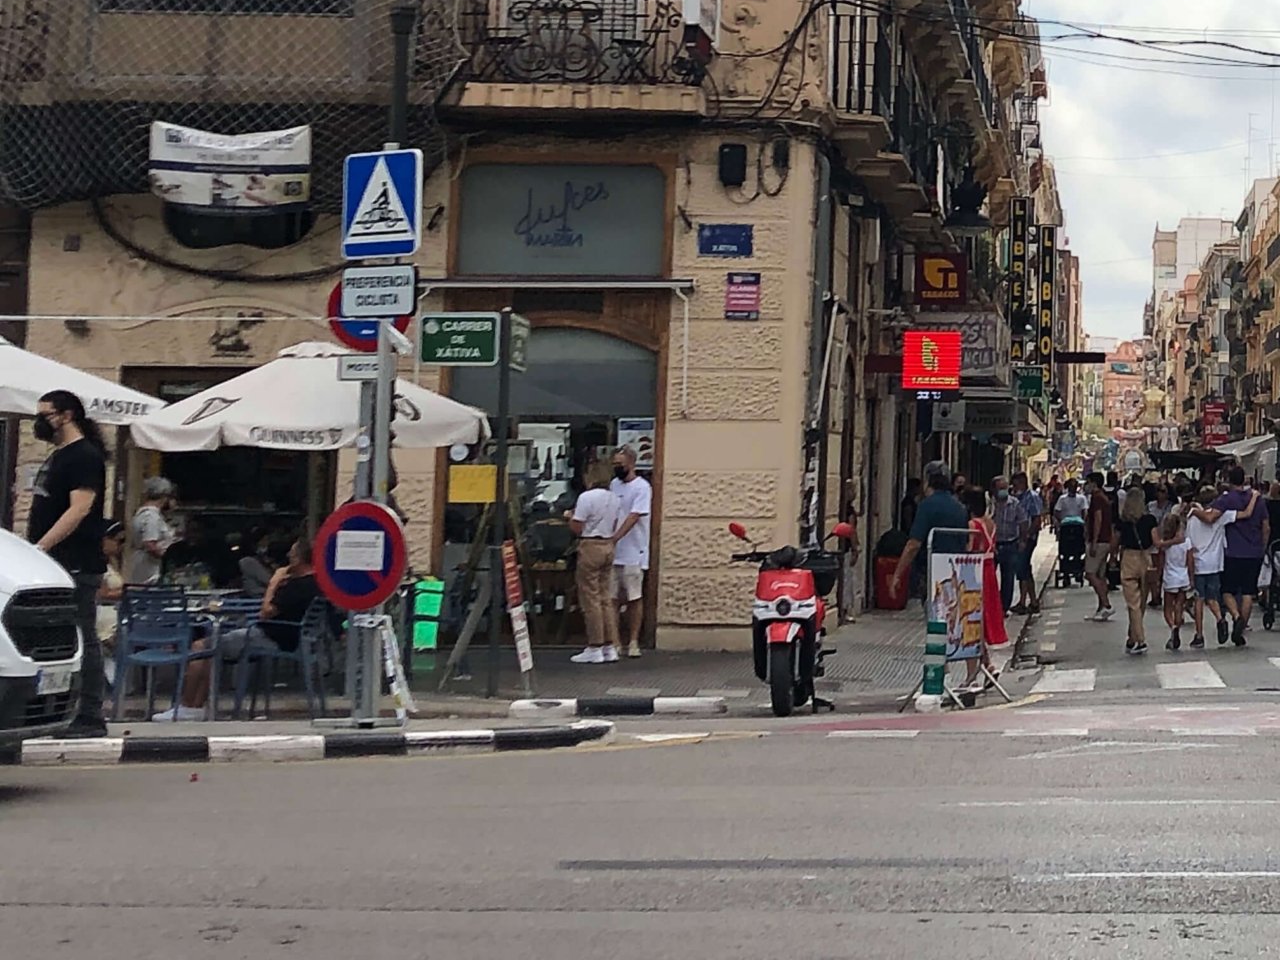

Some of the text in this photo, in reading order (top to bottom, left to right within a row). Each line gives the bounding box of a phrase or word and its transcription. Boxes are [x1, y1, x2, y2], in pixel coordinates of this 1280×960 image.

[345, 274, 411, 289] PREFERENCIA
[1011, 200, 1024, 358] LIBREA
[1040, 228, 1052, 382] LIBROS
[441, 320, 493, 332] CARRER
[450, 334, 467, 344] DE
[347, 363, 379, 372] MOTO
[90, 397, 150, 416] AMSTEL
[250, 426, 325, 445] GUINNESS
